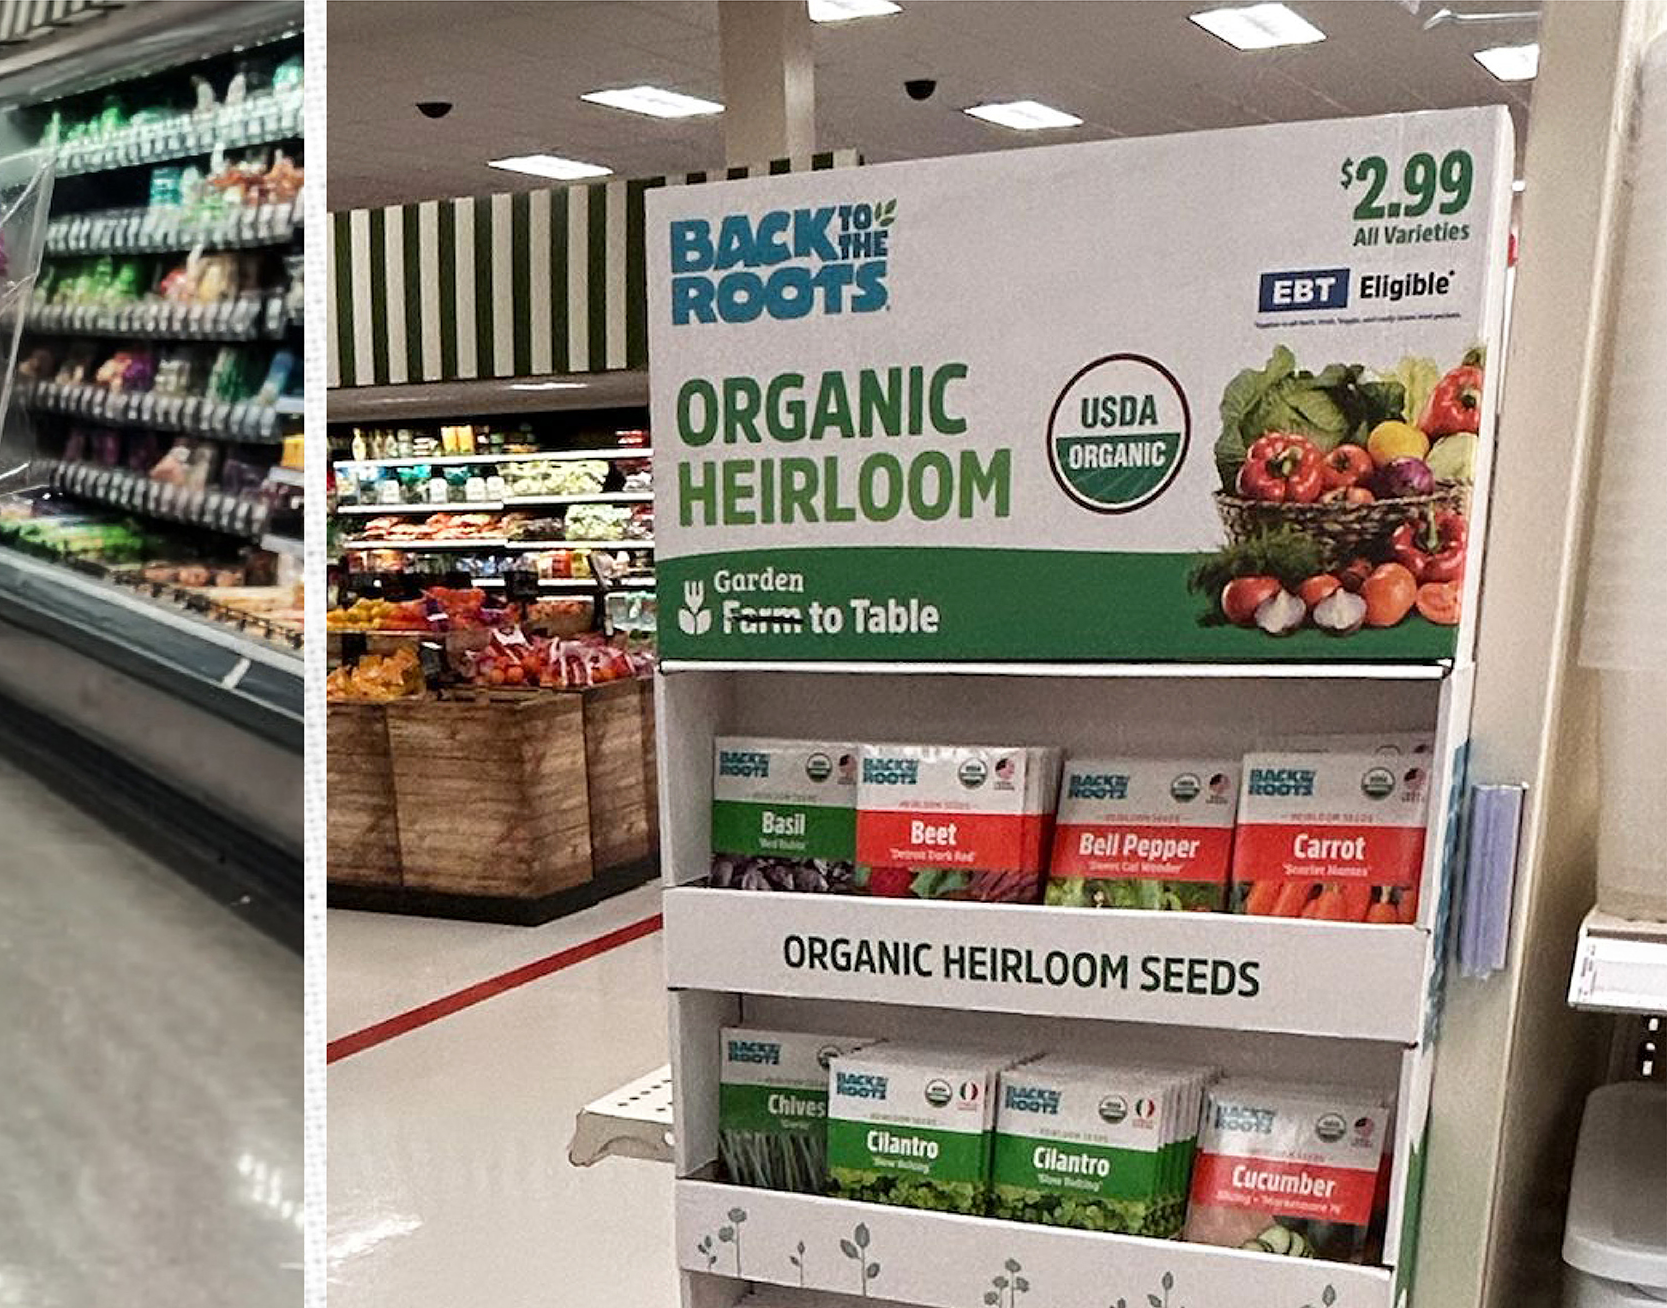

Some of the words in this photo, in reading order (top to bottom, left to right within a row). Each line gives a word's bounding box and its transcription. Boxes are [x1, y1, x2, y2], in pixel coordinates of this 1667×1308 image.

[1340, 148, 1474, 222] $2.99
[670, 203, 841, 275] BACK
[838, 205, 874, 231] TO
[837, 229, 889, 260] THE
[1353, 225, 1379, 247] All
[1383, 220, 1471, 246] Varieties
[671, 259, 890, 326] ROOTS
[1271, 276, 1336, 307] EBT
[676, 362, 969, 447] ORGANIC
[1079, 394, 1159, 431] USDA
[1068, 440, 1167, 472] ORGANIC
[678, 448, 1013, 528] HEIRLOOM
[714, 568, 804, 594] Garden
[808, 601, 843, 634] to
[849, 599, 940, 635] Table
[762, 811, 805, 836] Basil
[911, 820, 957, 846] Beet
[1079, 833, 1119, 857] Bell
[1123, 835, 1200, 862] Pepper
[1293, 833, 1366, 861] Carrot
[784, 934, 933, 978] ORGANIC
[943, 946, 1129, 990] HEIRLOOM
[1140, 955, 1260, 997] SEEDS
[767, 1094, 825, 1118] Chives
[866, 1130, 939, 1159] Cilantro
[1032, 1146, 1110, 1177] Cilantro
[1232, 1165, 1336, 1198] Cucumber
